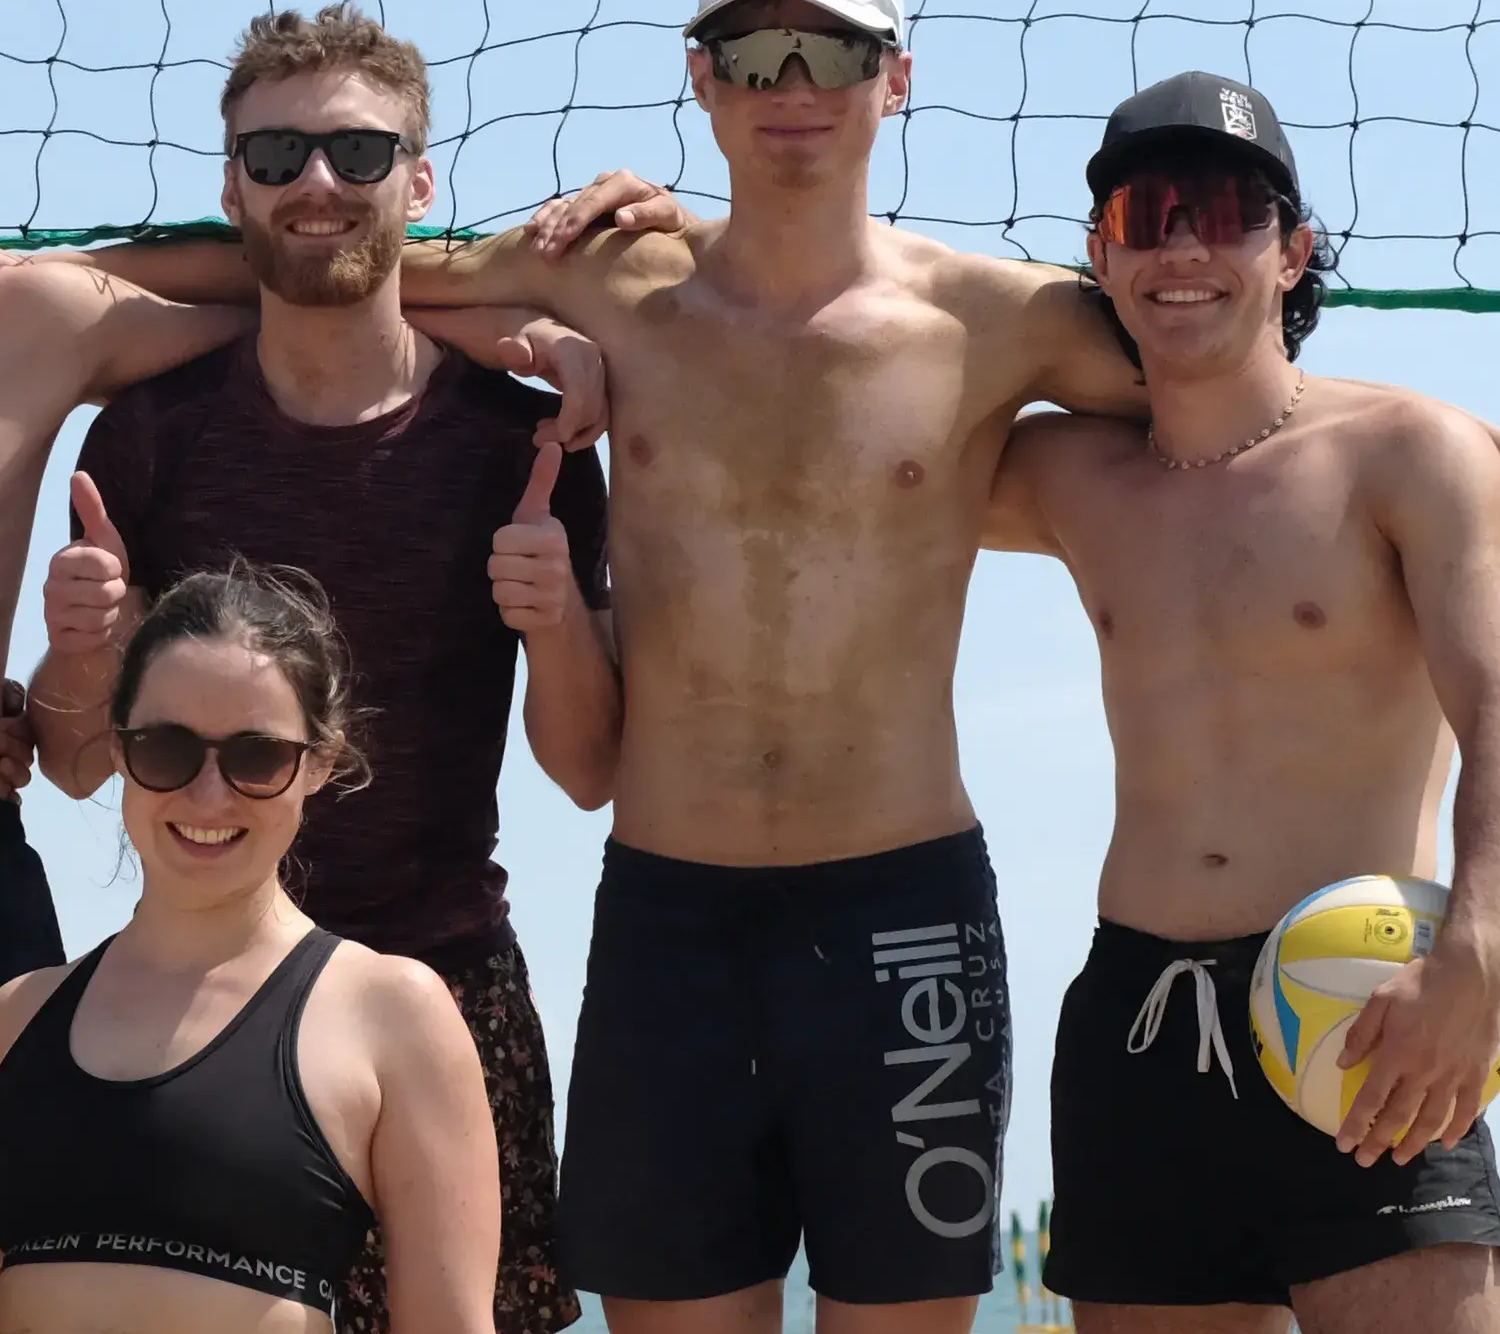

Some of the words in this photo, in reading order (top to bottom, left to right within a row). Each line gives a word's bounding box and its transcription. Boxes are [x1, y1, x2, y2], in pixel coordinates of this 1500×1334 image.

[965, 922, 994, 1042] CRUZ
[872, 922, 995, 1238] O'Neill
[96, 1233, 307, 1290] PERFORMANCE
